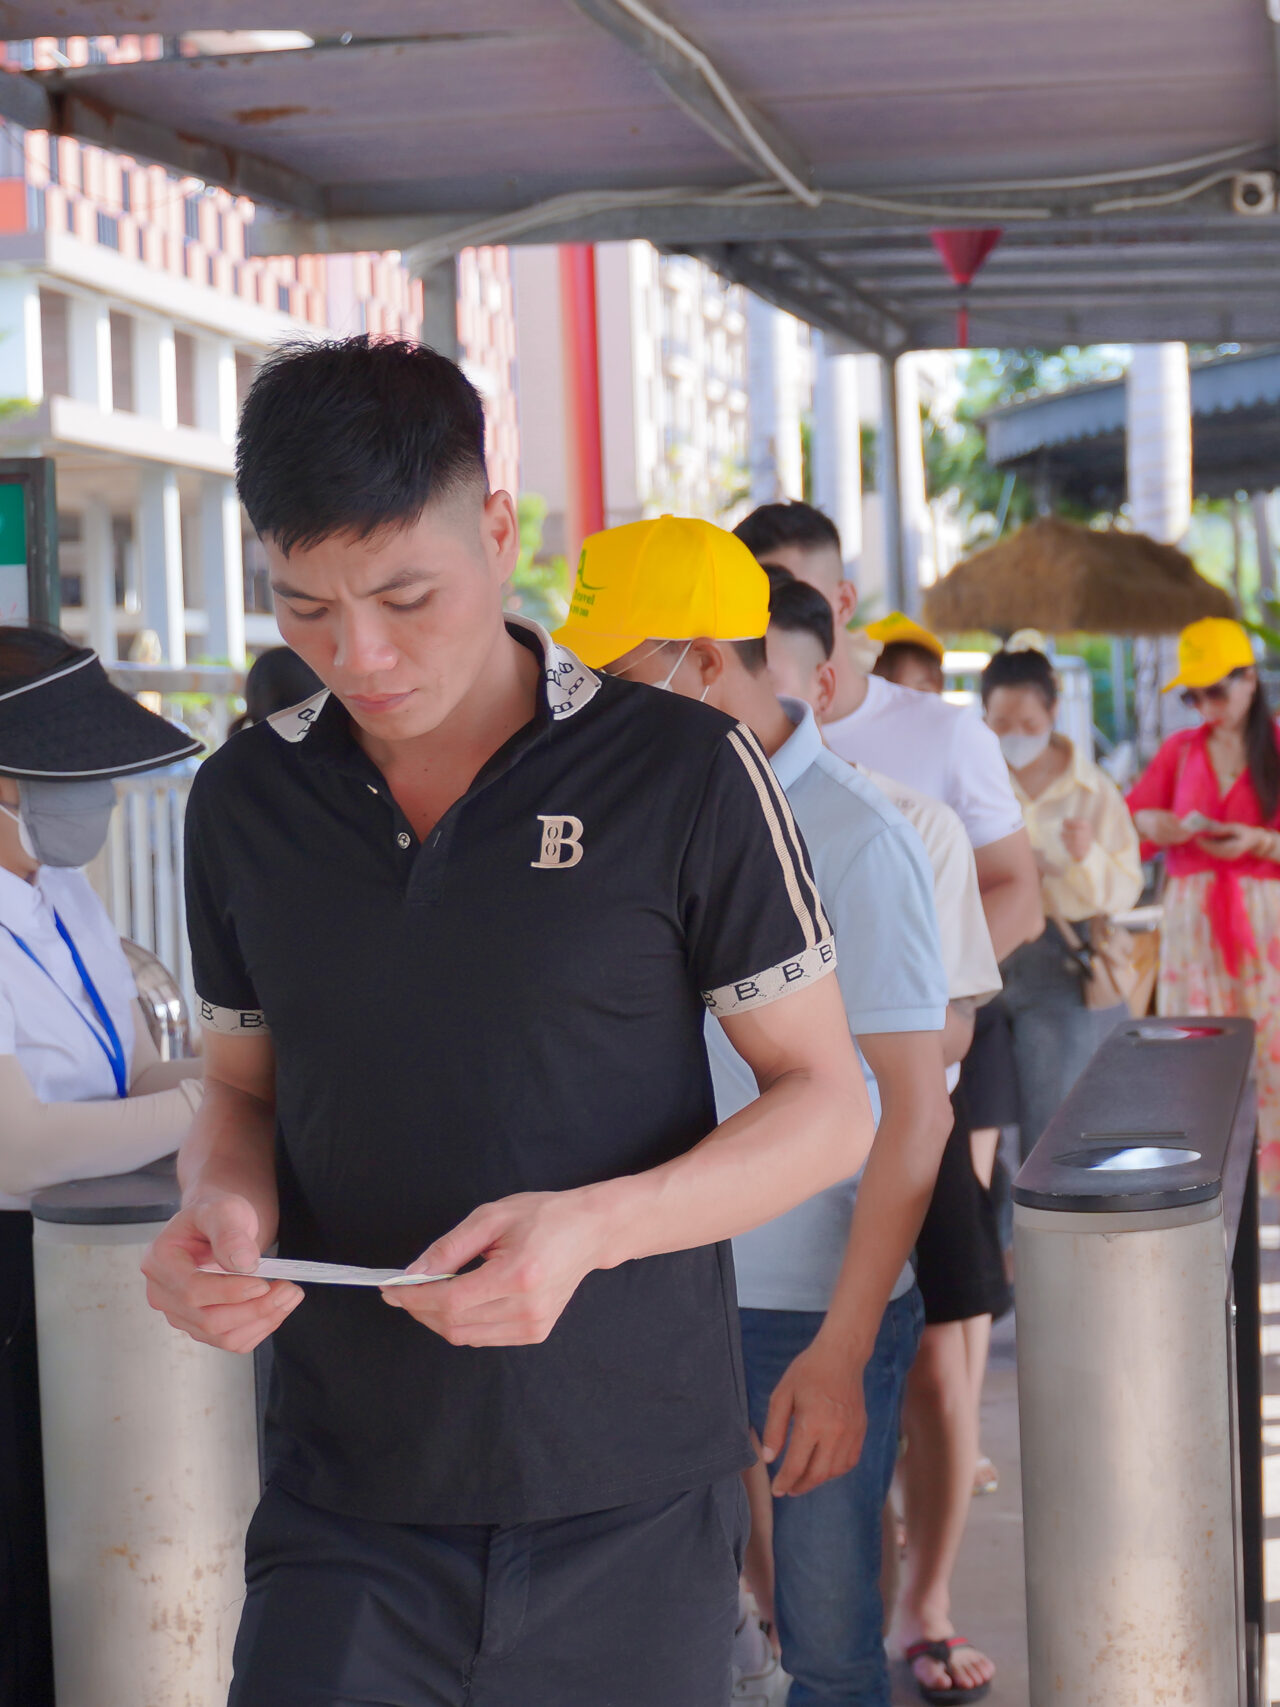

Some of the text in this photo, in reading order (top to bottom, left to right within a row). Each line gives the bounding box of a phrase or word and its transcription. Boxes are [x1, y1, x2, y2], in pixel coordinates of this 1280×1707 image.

[734, 981, 760, 1002] B
[782, 962, 805, 983] B
[819, 944, 834, 964] B
